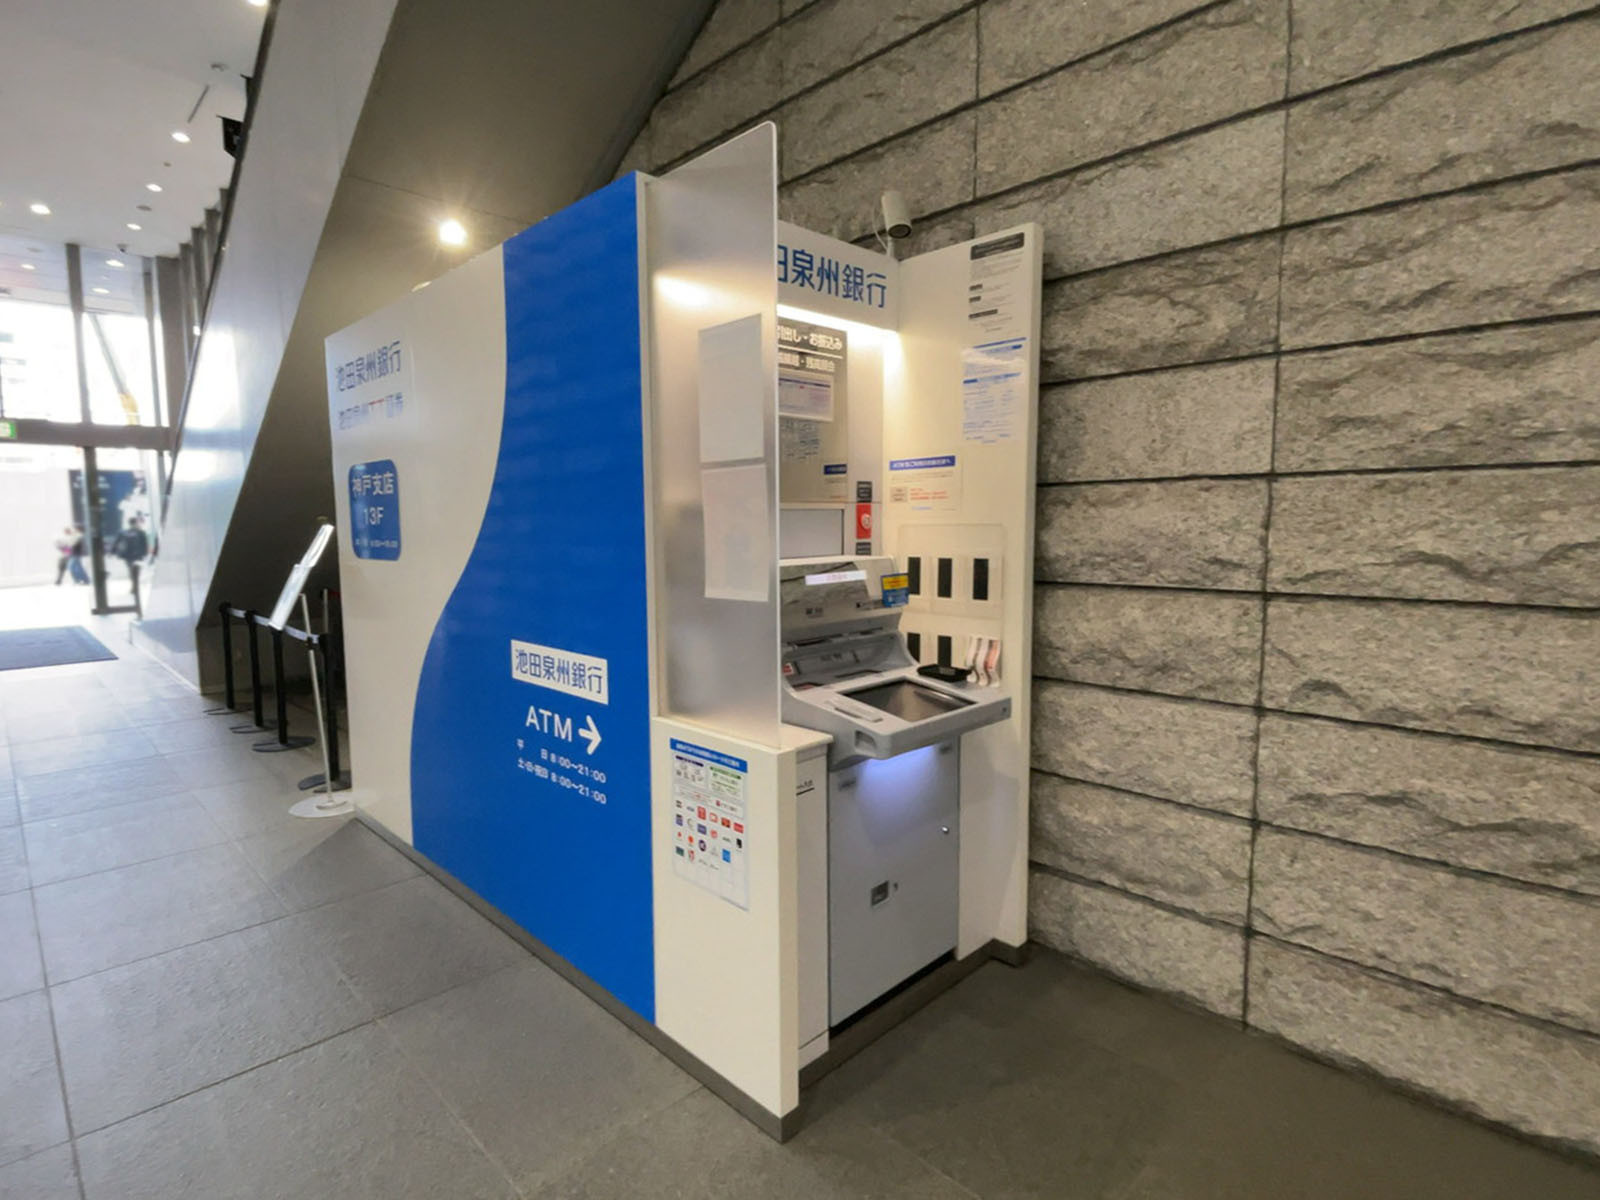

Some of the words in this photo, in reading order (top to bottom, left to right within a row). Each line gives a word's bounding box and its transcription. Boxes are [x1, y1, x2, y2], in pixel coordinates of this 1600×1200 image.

[336, 341, 401, 391] 池田泉州銀行
[352, 472, 394, 496] 神戸支店
[363, 507, 384, 525] 13F
[515, 648, 603, 694] 池田泉州銀行
[525, 705, 572, 742] ATM
